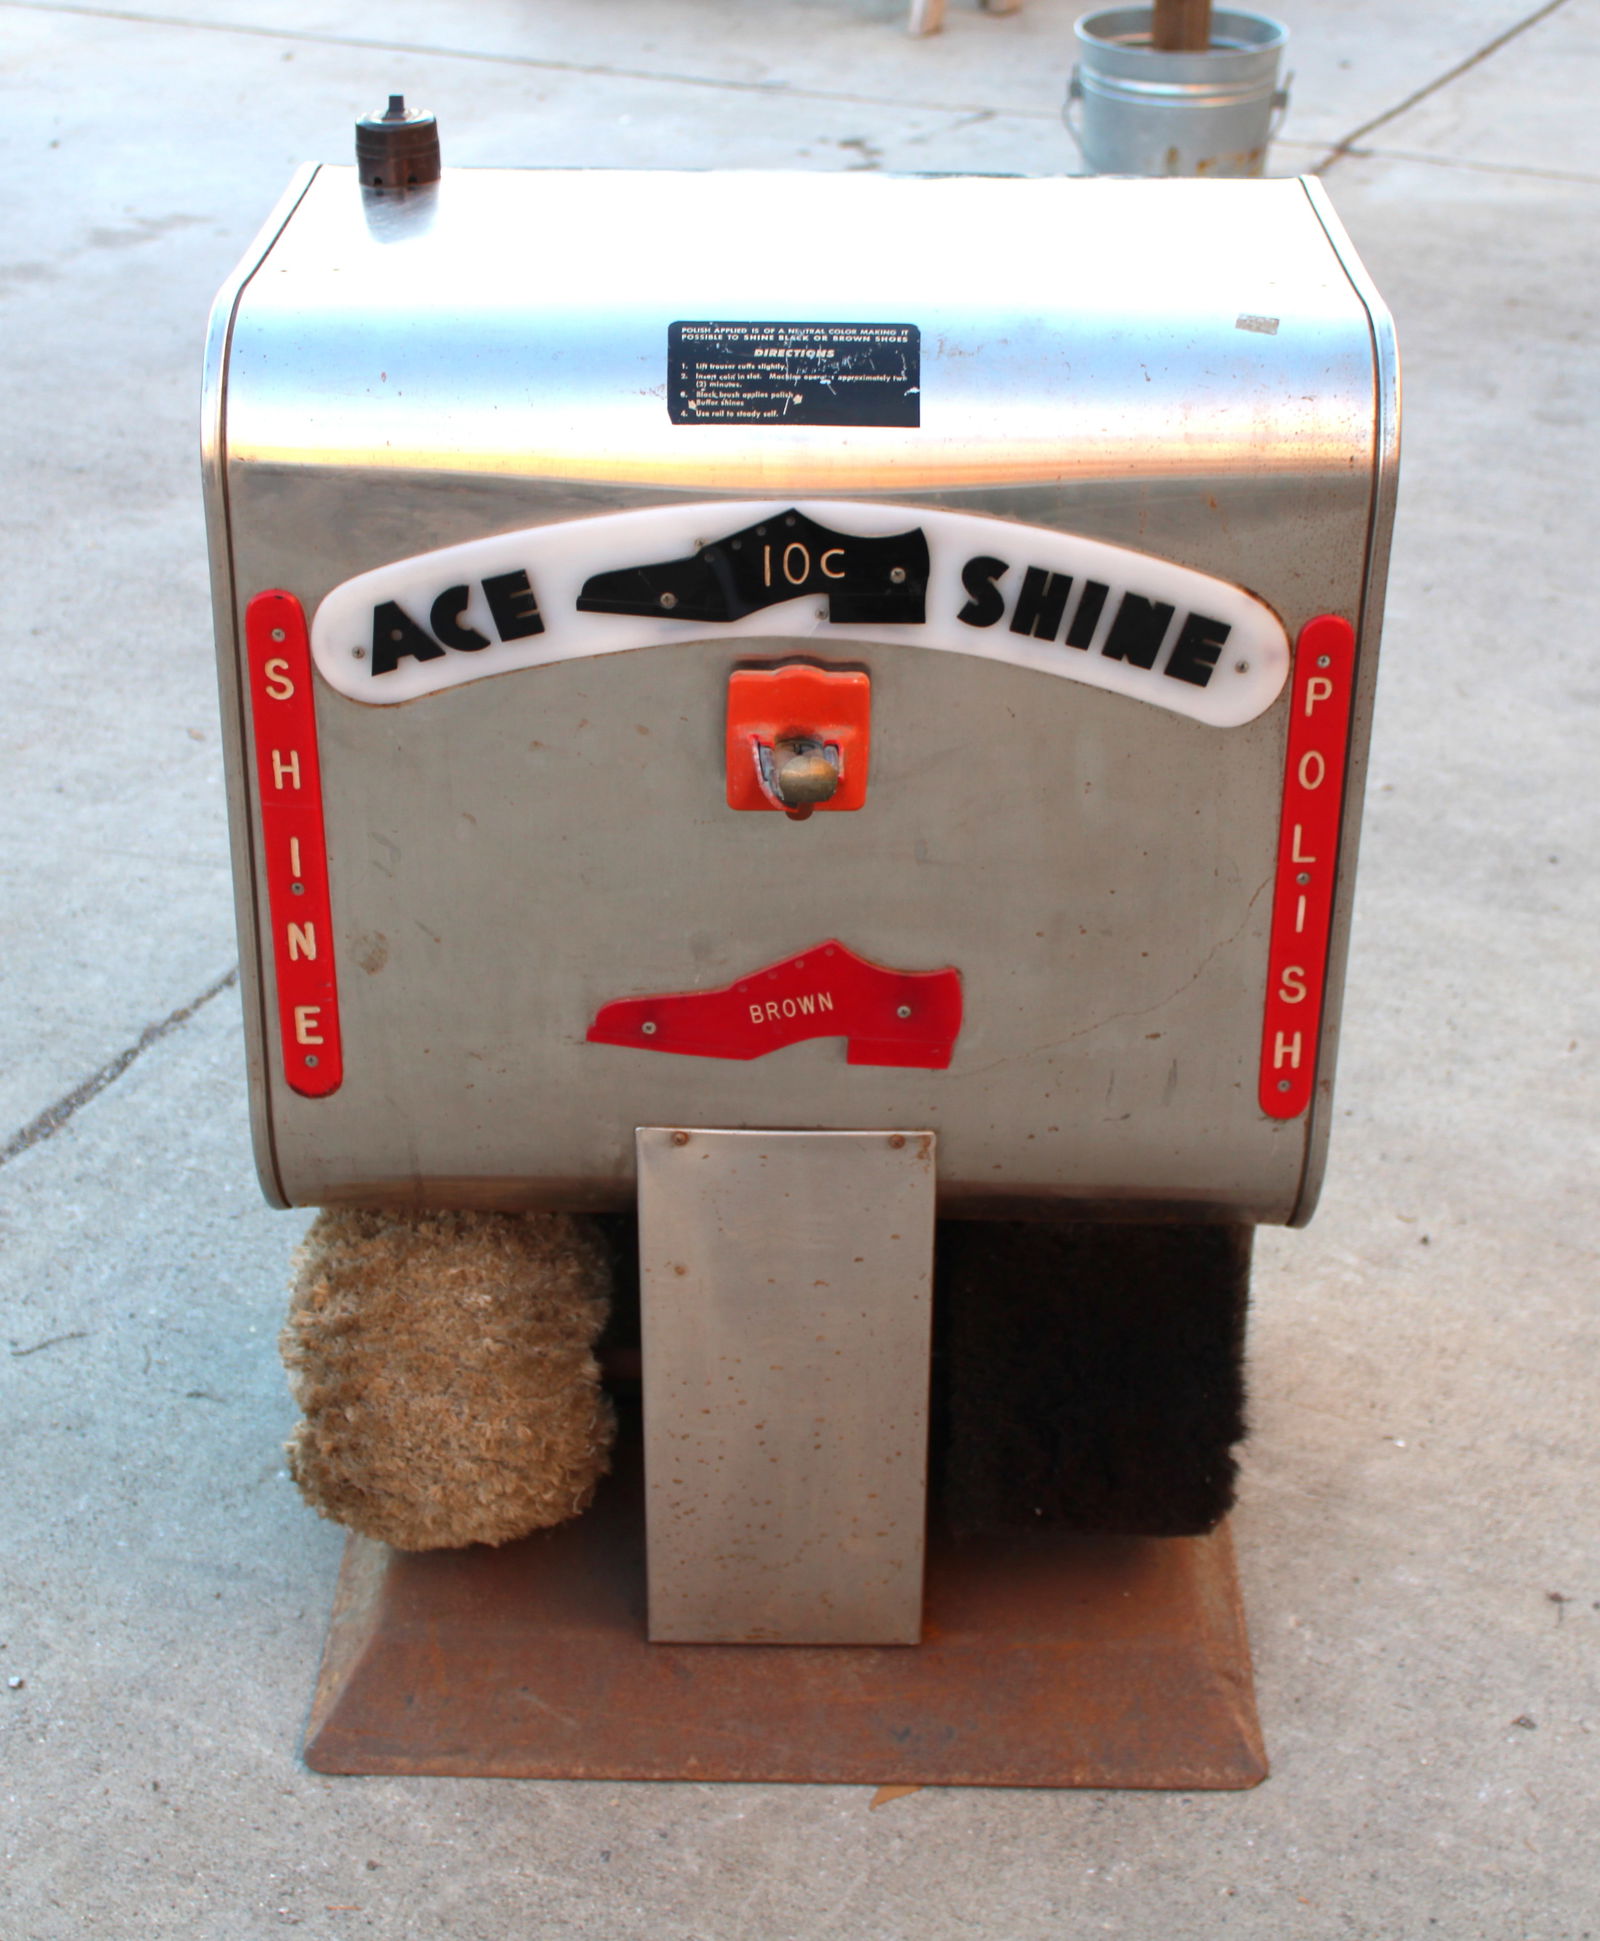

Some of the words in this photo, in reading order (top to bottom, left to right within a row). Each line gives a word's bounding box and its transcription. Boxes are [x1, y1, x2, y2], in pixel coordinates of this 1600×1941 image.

[753, 348, 835, 358] DIRECTIONS
[742, 391, 768, 400] applies
[838, 375, 891, 383] approximately
[736, 410, 760, 419] steady
[372, 569, 545, 677] ACE
[956, 556, 1232, 688] SHINE
[265, 658, 324, 1046] SHINE
[1273, 676, 1334, 1070] POLISH
[749, 992, 834, 1025] BROWN
